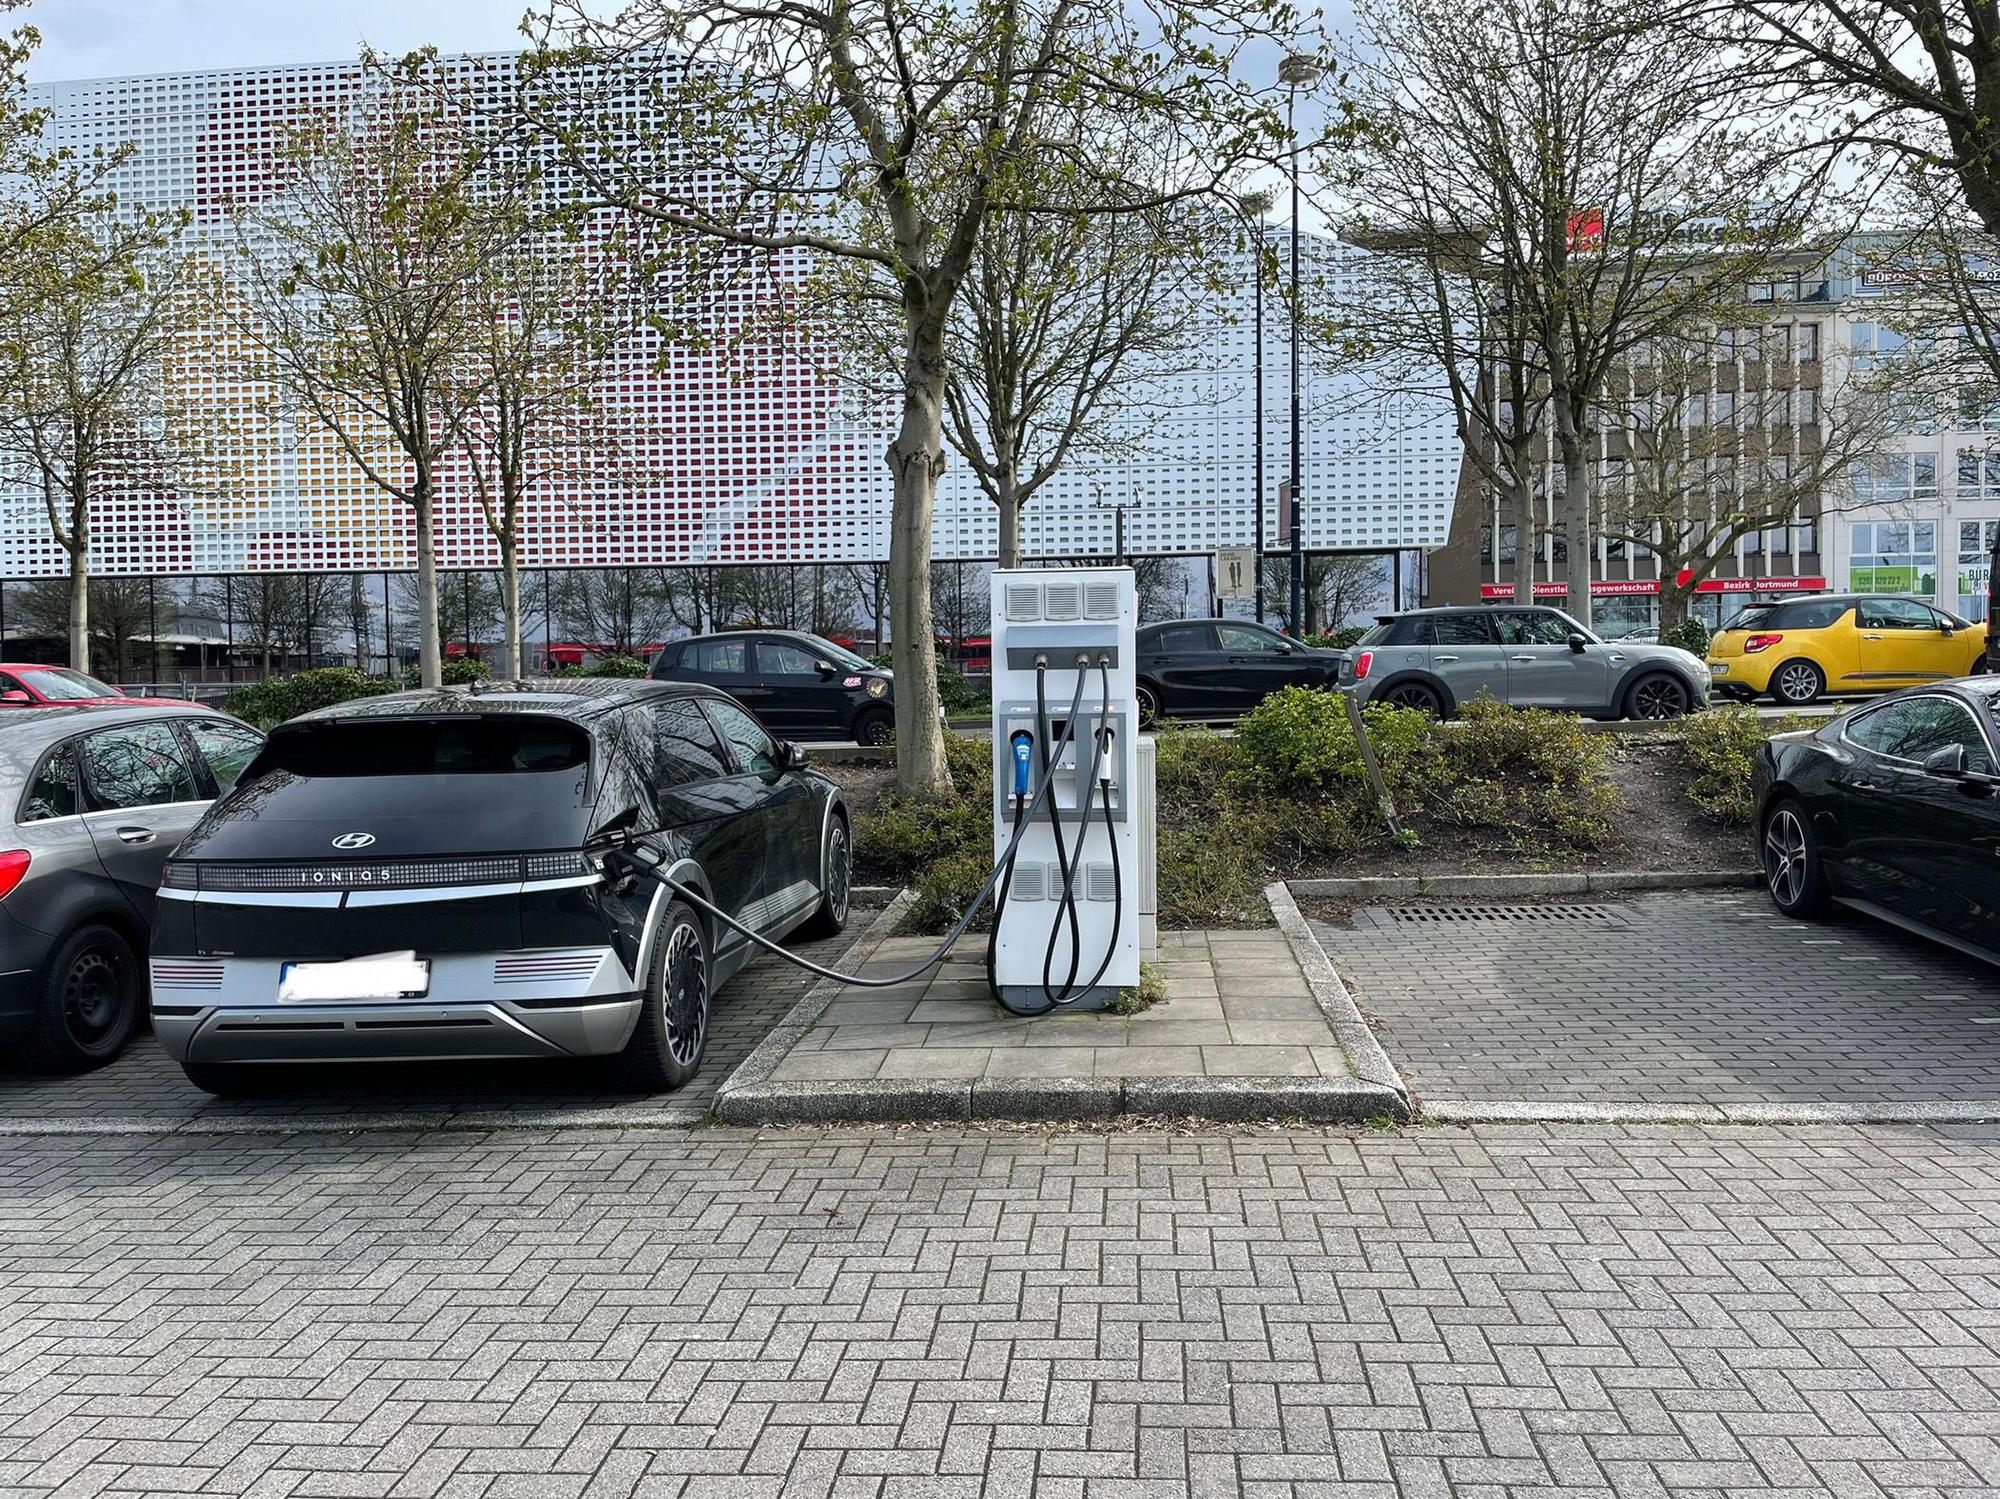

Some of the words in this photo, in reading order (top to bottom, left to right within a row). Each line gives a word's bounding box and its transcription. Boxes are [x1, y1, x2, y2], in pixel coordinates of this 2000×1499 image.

[1969, 567, 1989, 581] BÜR
[1493, 587, 1515, 595] Verei
[1723, 581, 1751, 590] Bezirk
[302, 870, 371, 882] IONIQ
[381, 869, 390, 880] 5
